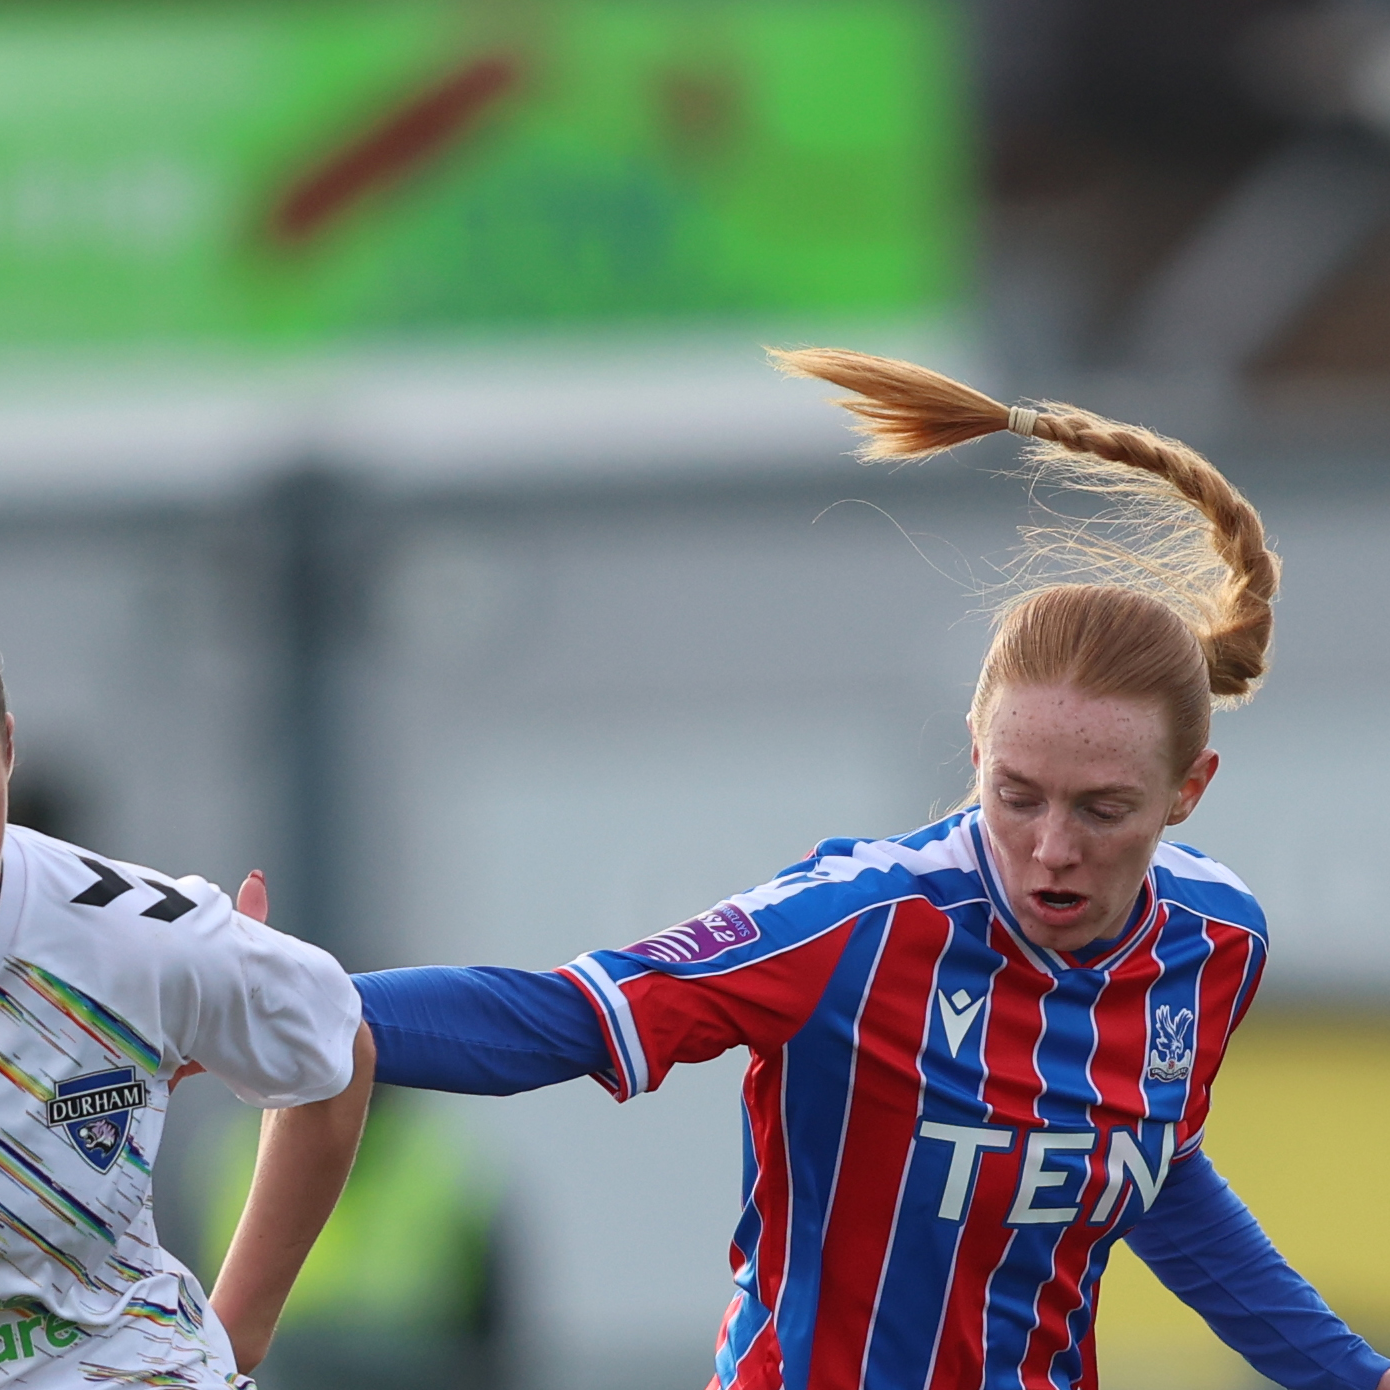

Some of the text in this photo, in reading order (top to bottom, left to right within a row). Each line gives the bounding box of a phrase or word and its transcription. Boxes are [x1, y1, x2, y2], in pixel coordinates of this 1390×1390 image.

[712, 930, 736, 942] 2
[53, 1086, 140, 1121] DURHAM
[918, 1120, 1175, 1225] TEN
